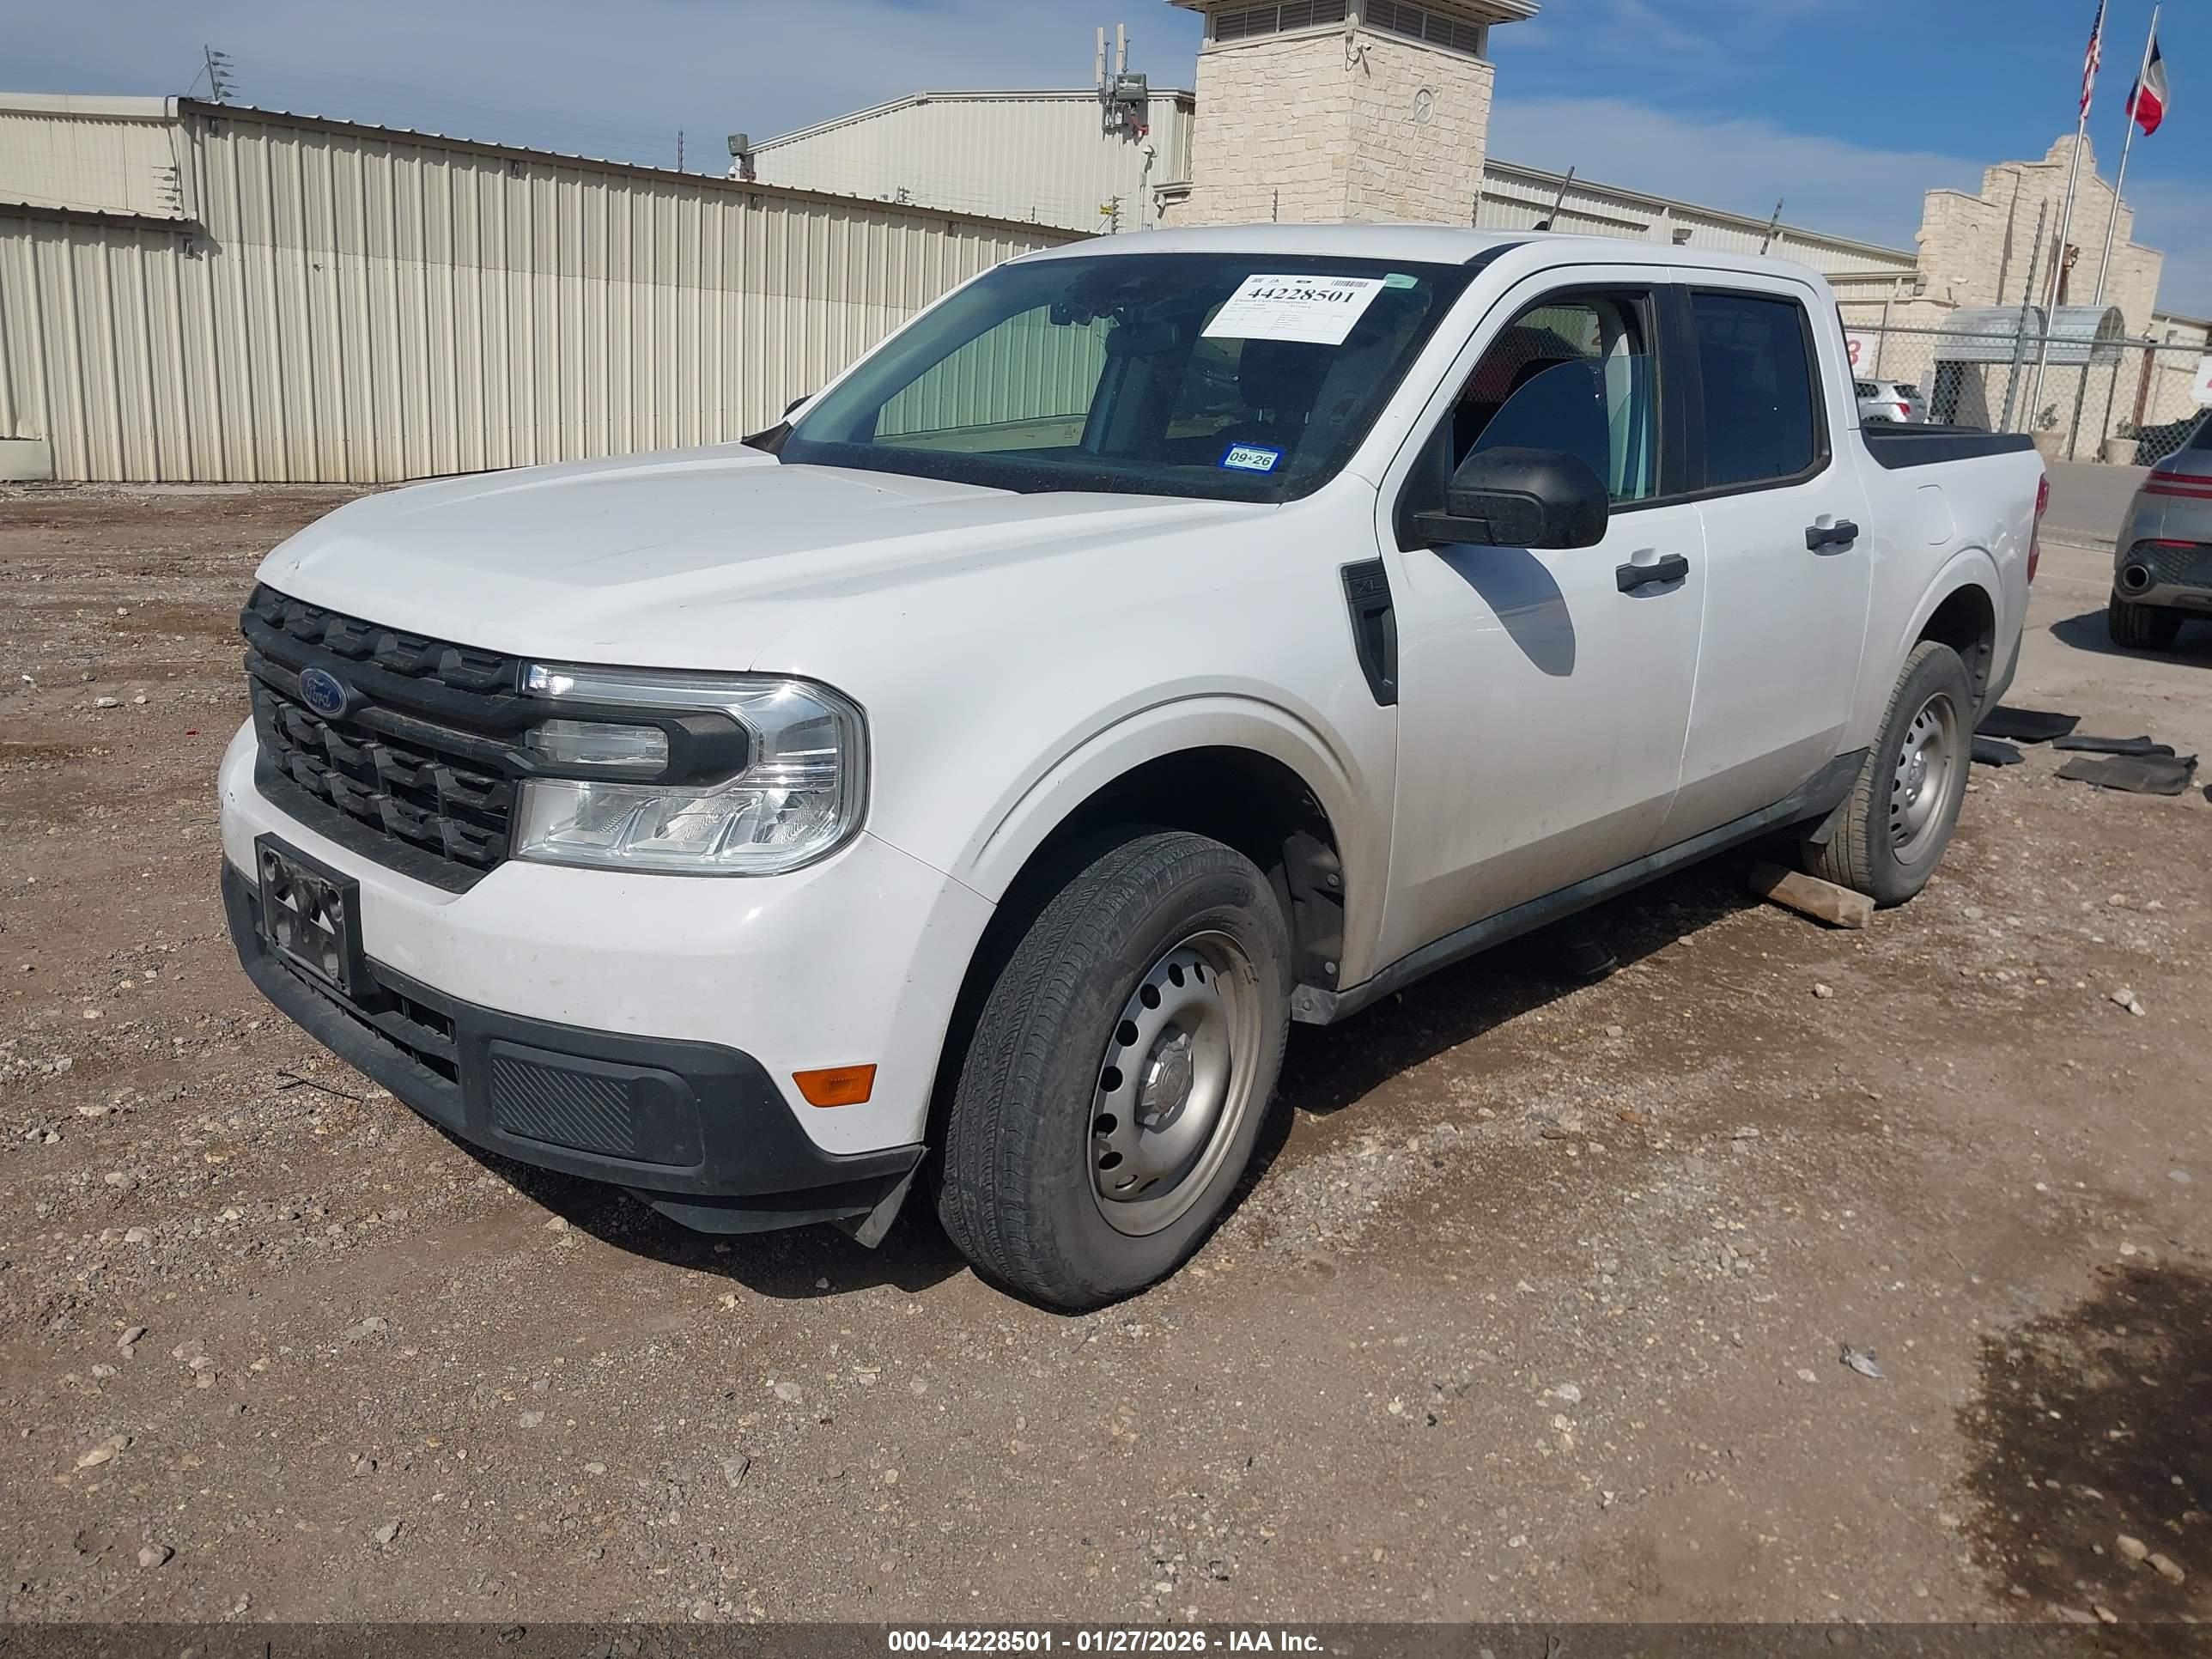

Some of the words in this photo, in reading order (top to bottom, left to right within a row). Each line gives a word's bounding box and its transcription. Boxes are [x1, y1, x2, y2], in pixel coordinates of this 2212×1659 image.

[1248, 287, 1355, 303] 44228501
[1230, 452, 1248, 463] 09
[1253, 455, 1272, 466] 26
[1356, 578, 1383, 593] XL
[306, 677, 331, 708] Ford
